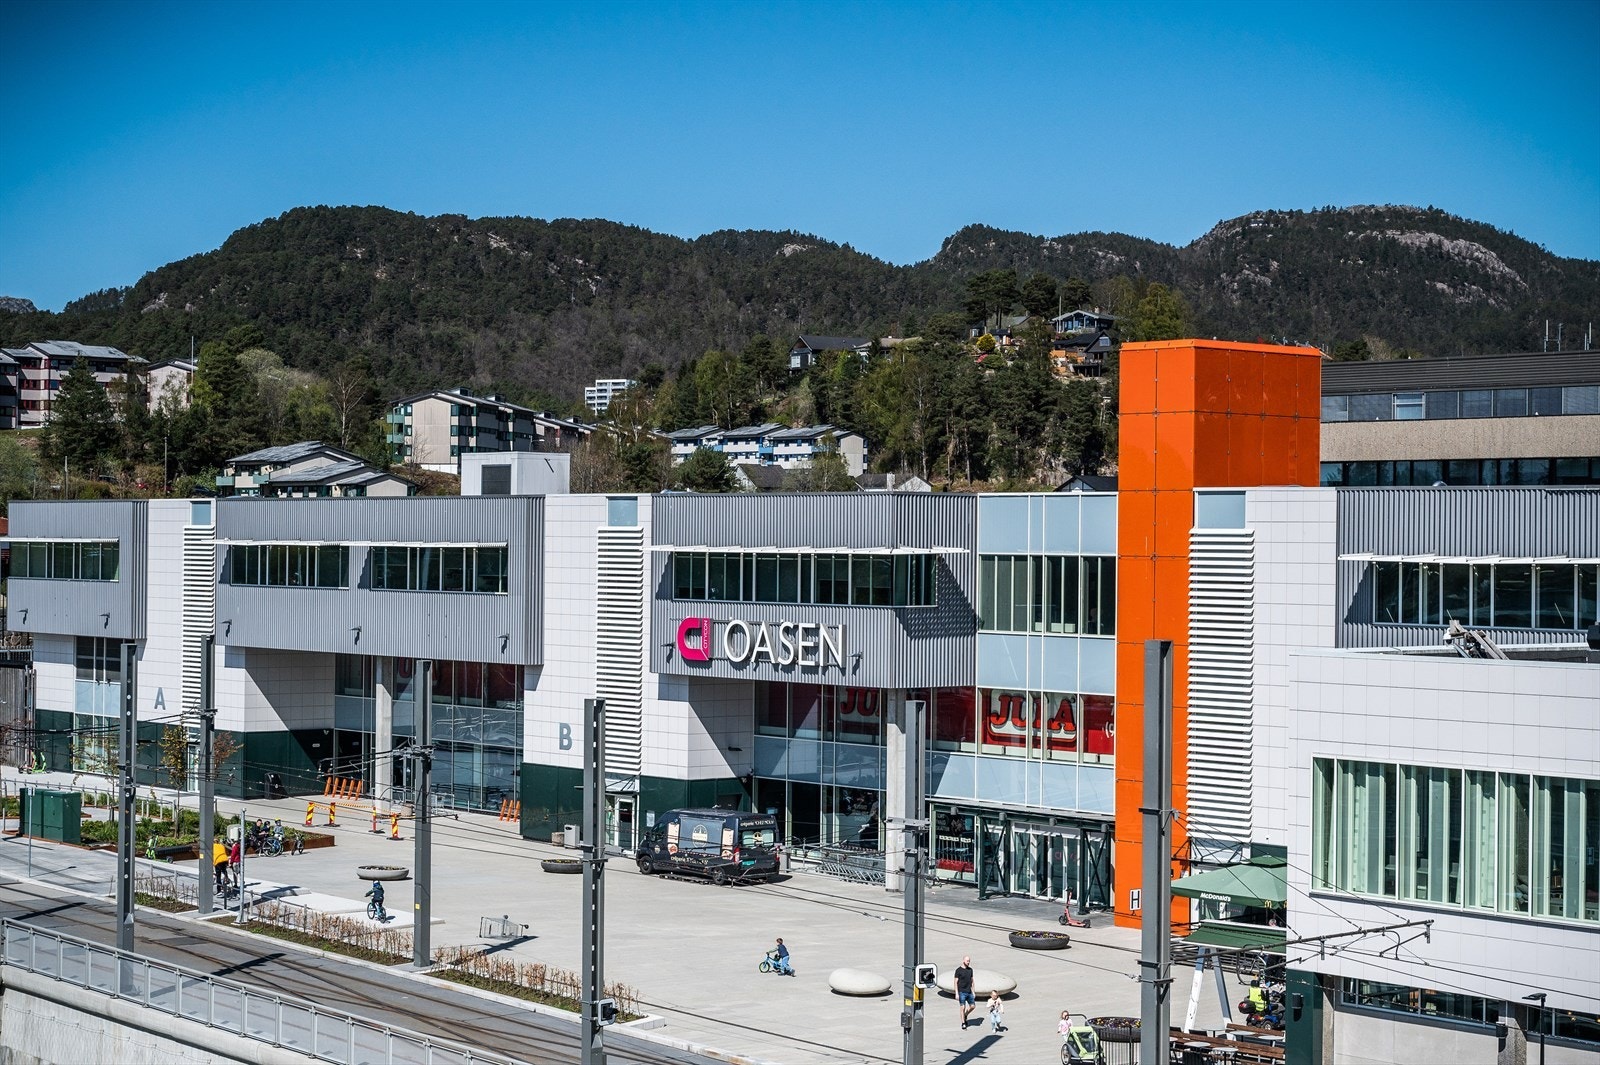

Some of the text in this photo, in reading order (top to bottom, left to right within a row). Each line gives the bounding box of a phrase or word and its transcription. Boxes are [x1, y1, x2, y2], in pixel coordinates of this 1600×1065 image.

[724, 619, 844, 668] OASEN
[154, 687, 166, 710] A
[989, 693, 1076, 732] JULA
[559, 722, 573, 750] B
[1131, 890, 1140, 910] H
[1200, 892, 1231, 902] McDonald's
